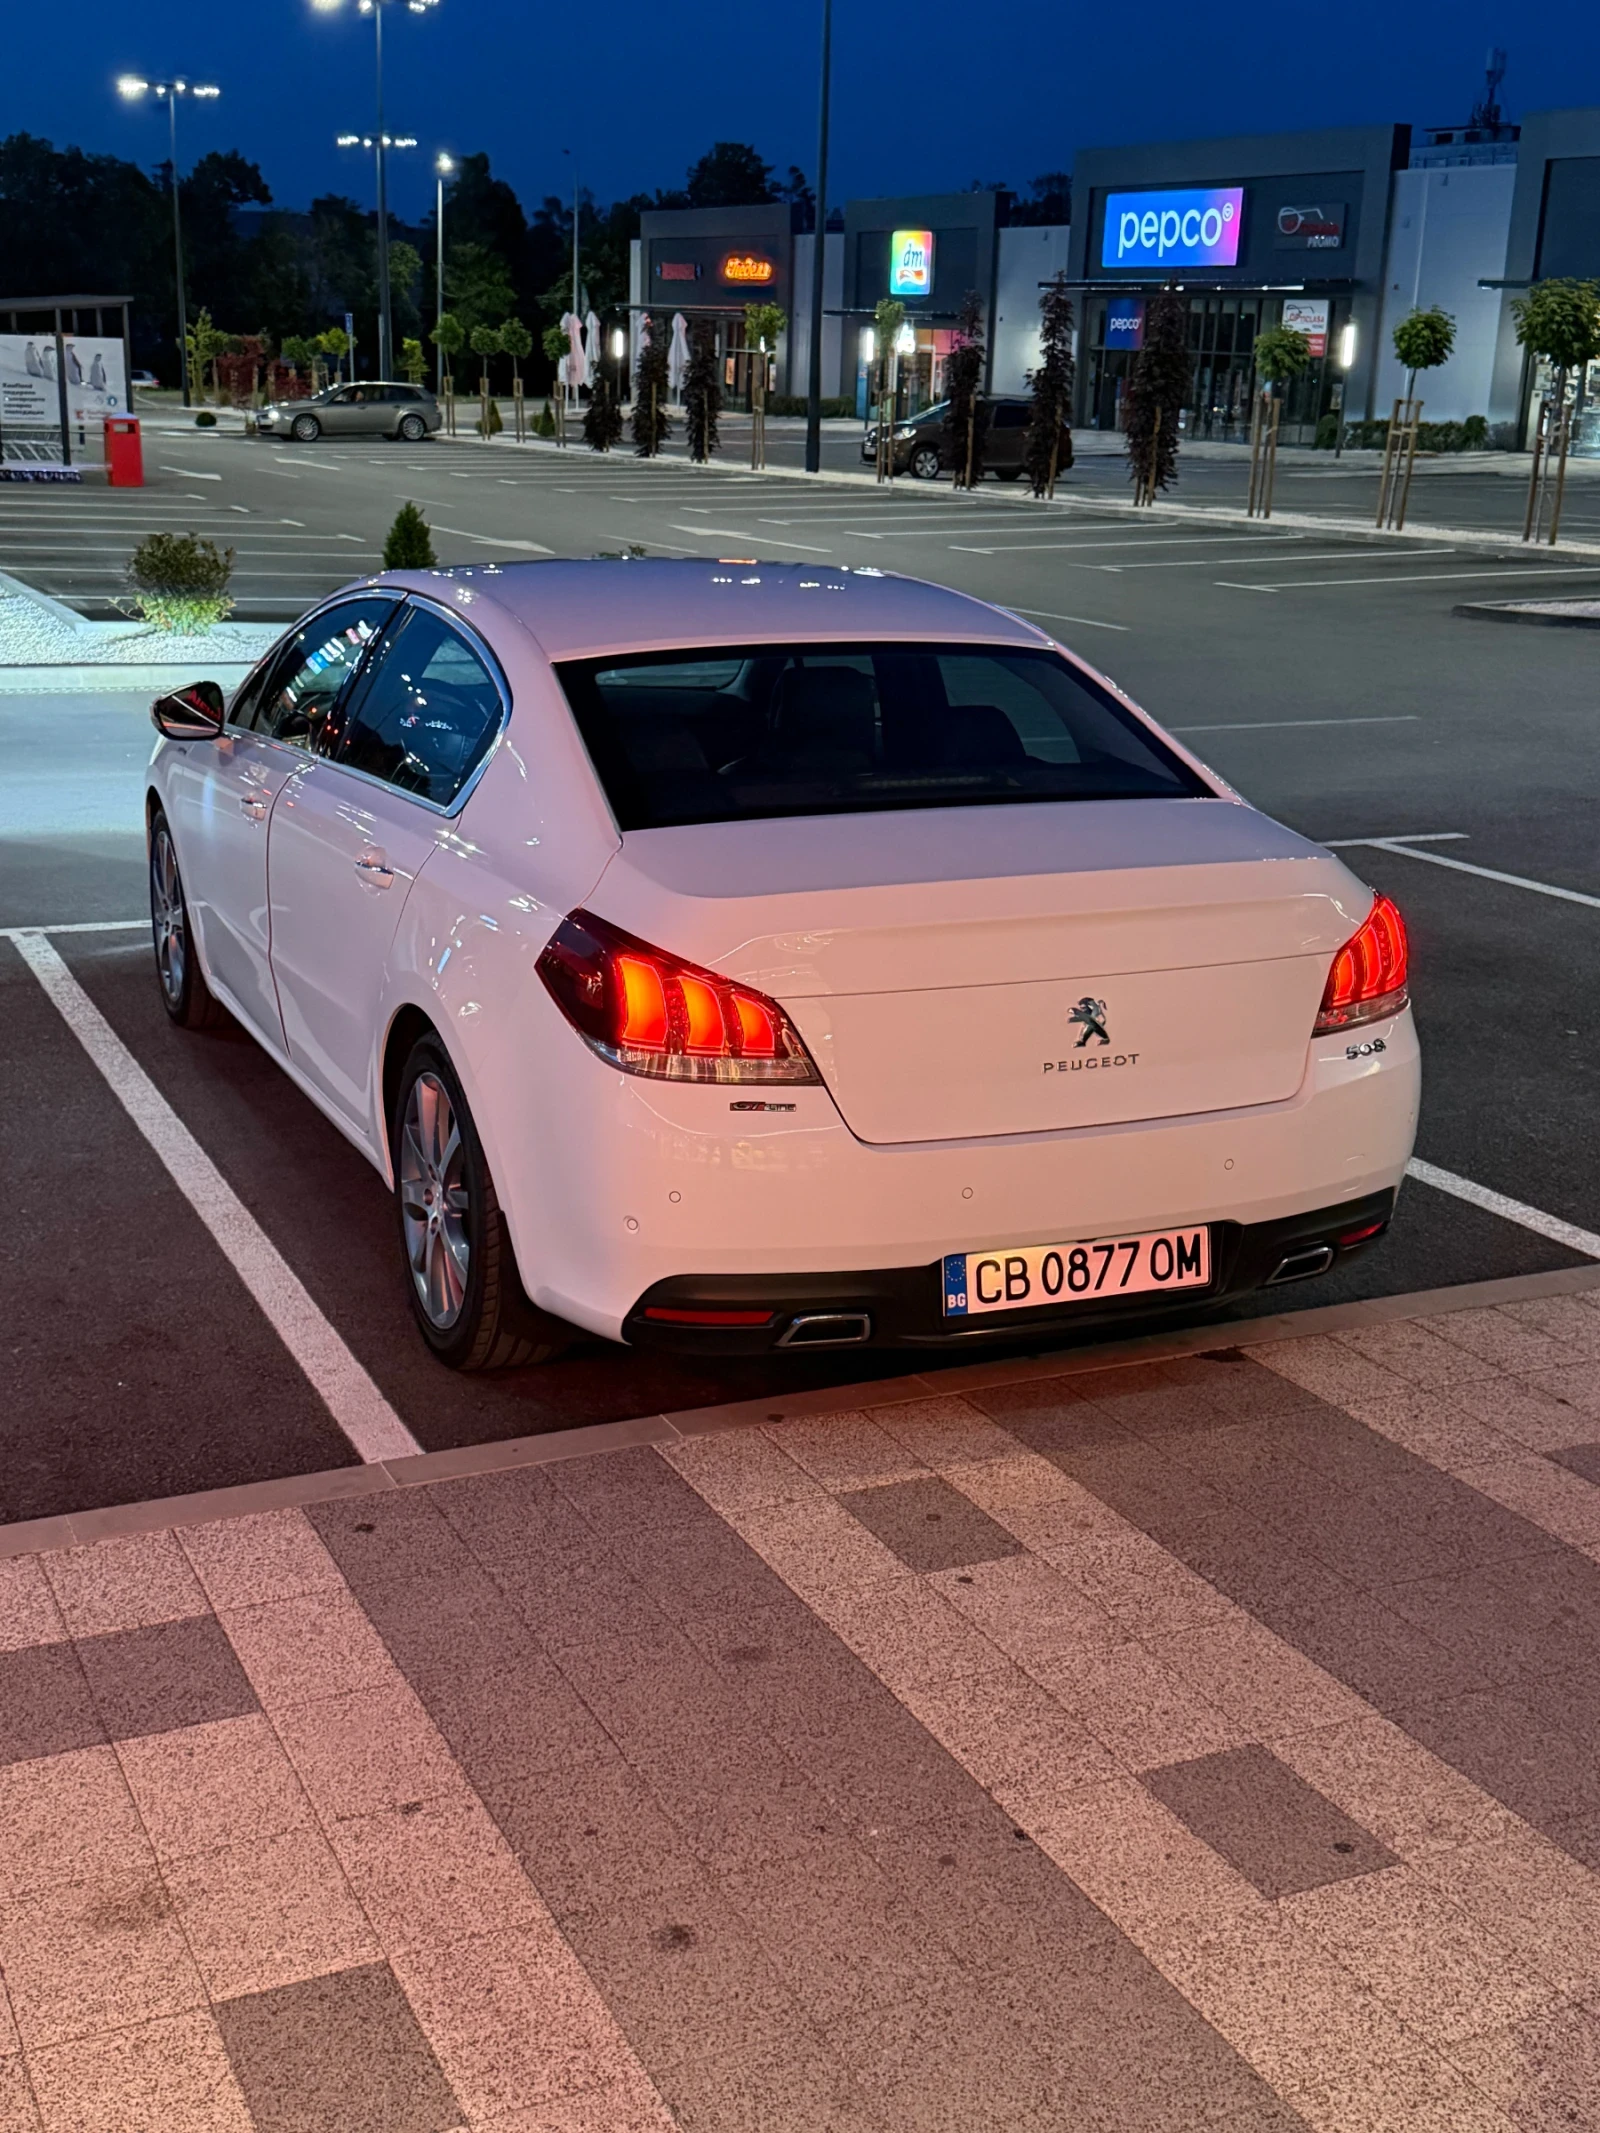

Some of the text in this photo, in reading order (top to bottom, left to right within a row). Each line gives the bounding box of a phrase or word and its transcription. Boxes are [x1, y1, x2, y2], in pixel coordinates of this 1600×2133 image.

[1118, 207, 1222, 258] pepco
[903, 243, 923, 267] dm
[1110, 317, 1139, 332] pepco
[1346, 1038, 1386, 1060] 508
[1043, 1053, 1140, 1074] PEUGEOT
[975, 1233, 1202, 1304] CB 0877 OM
[947, 1293, 966, 1308] BG
